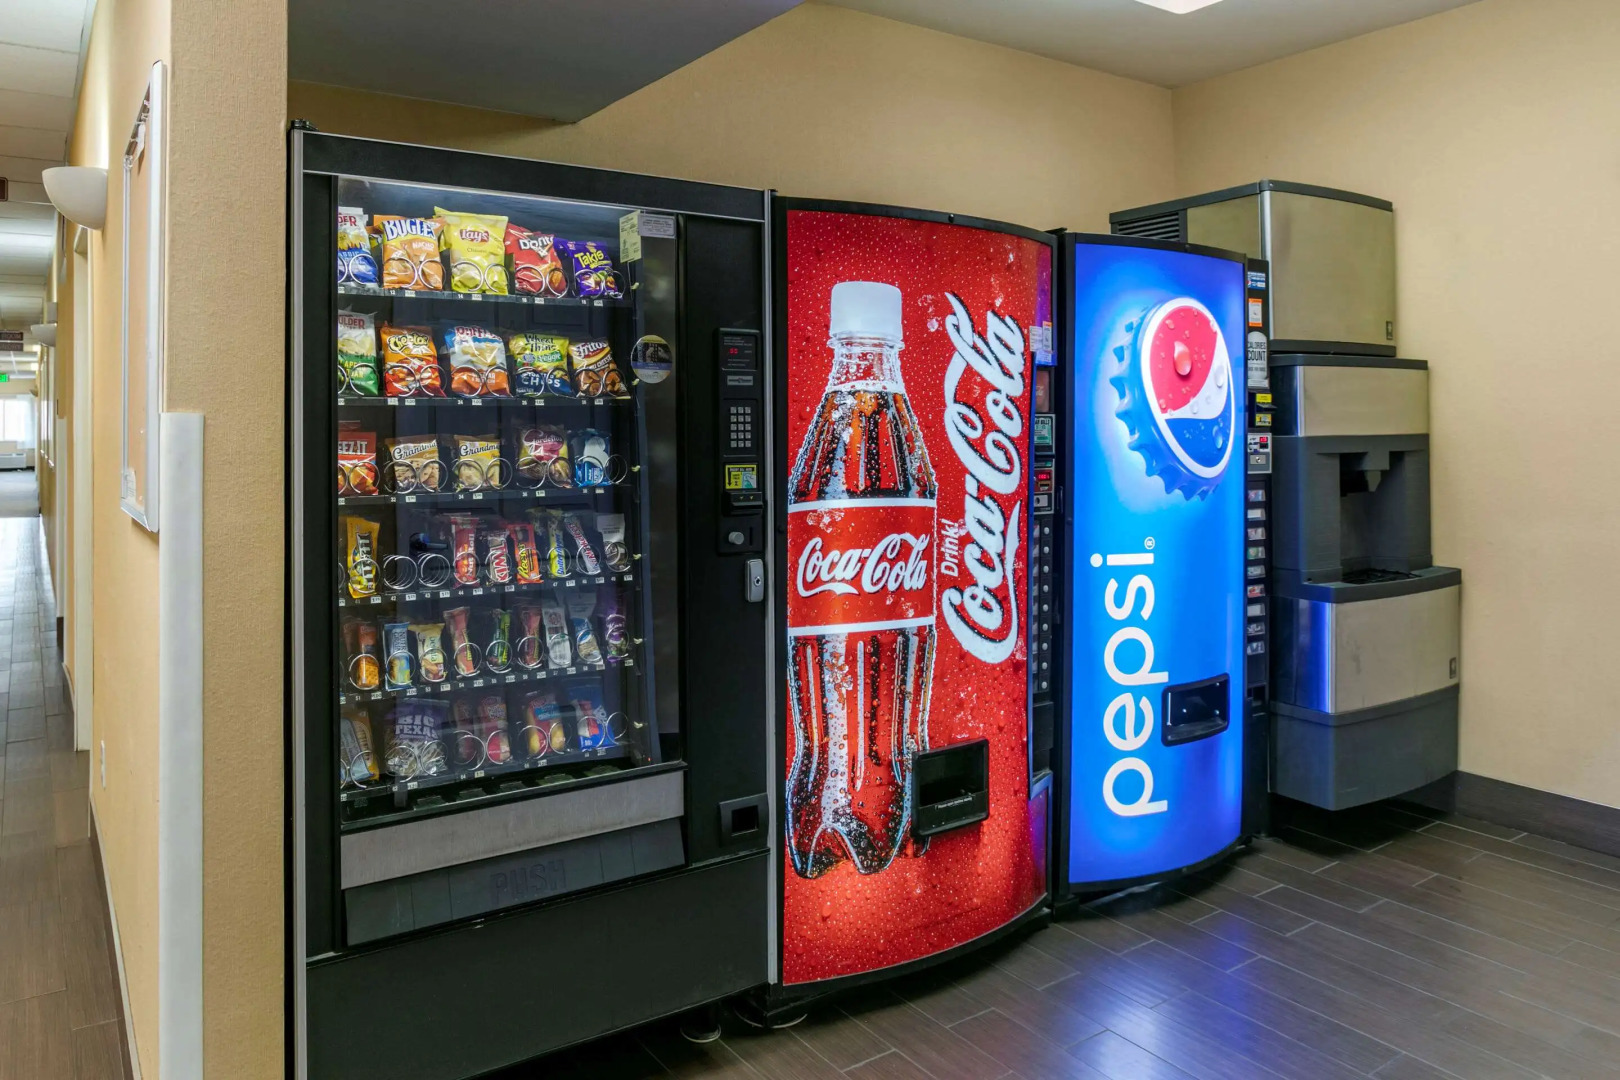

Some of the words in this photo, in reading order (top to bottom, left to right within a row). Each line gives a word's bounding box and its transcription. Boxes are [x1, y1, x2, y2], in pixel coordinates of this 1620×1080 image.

[574, 250, 605, 268] Takis
[525, 334, 554, 344] Wheat
[575, 341, 610, 360] Fritos
[942, 291, 1025, 664] Coca-Cola
[797, 533, 930, 597] Coca-Cola
[941, 518, 959, 578] Drink!
[491, 859, 567, 906] PUSH
